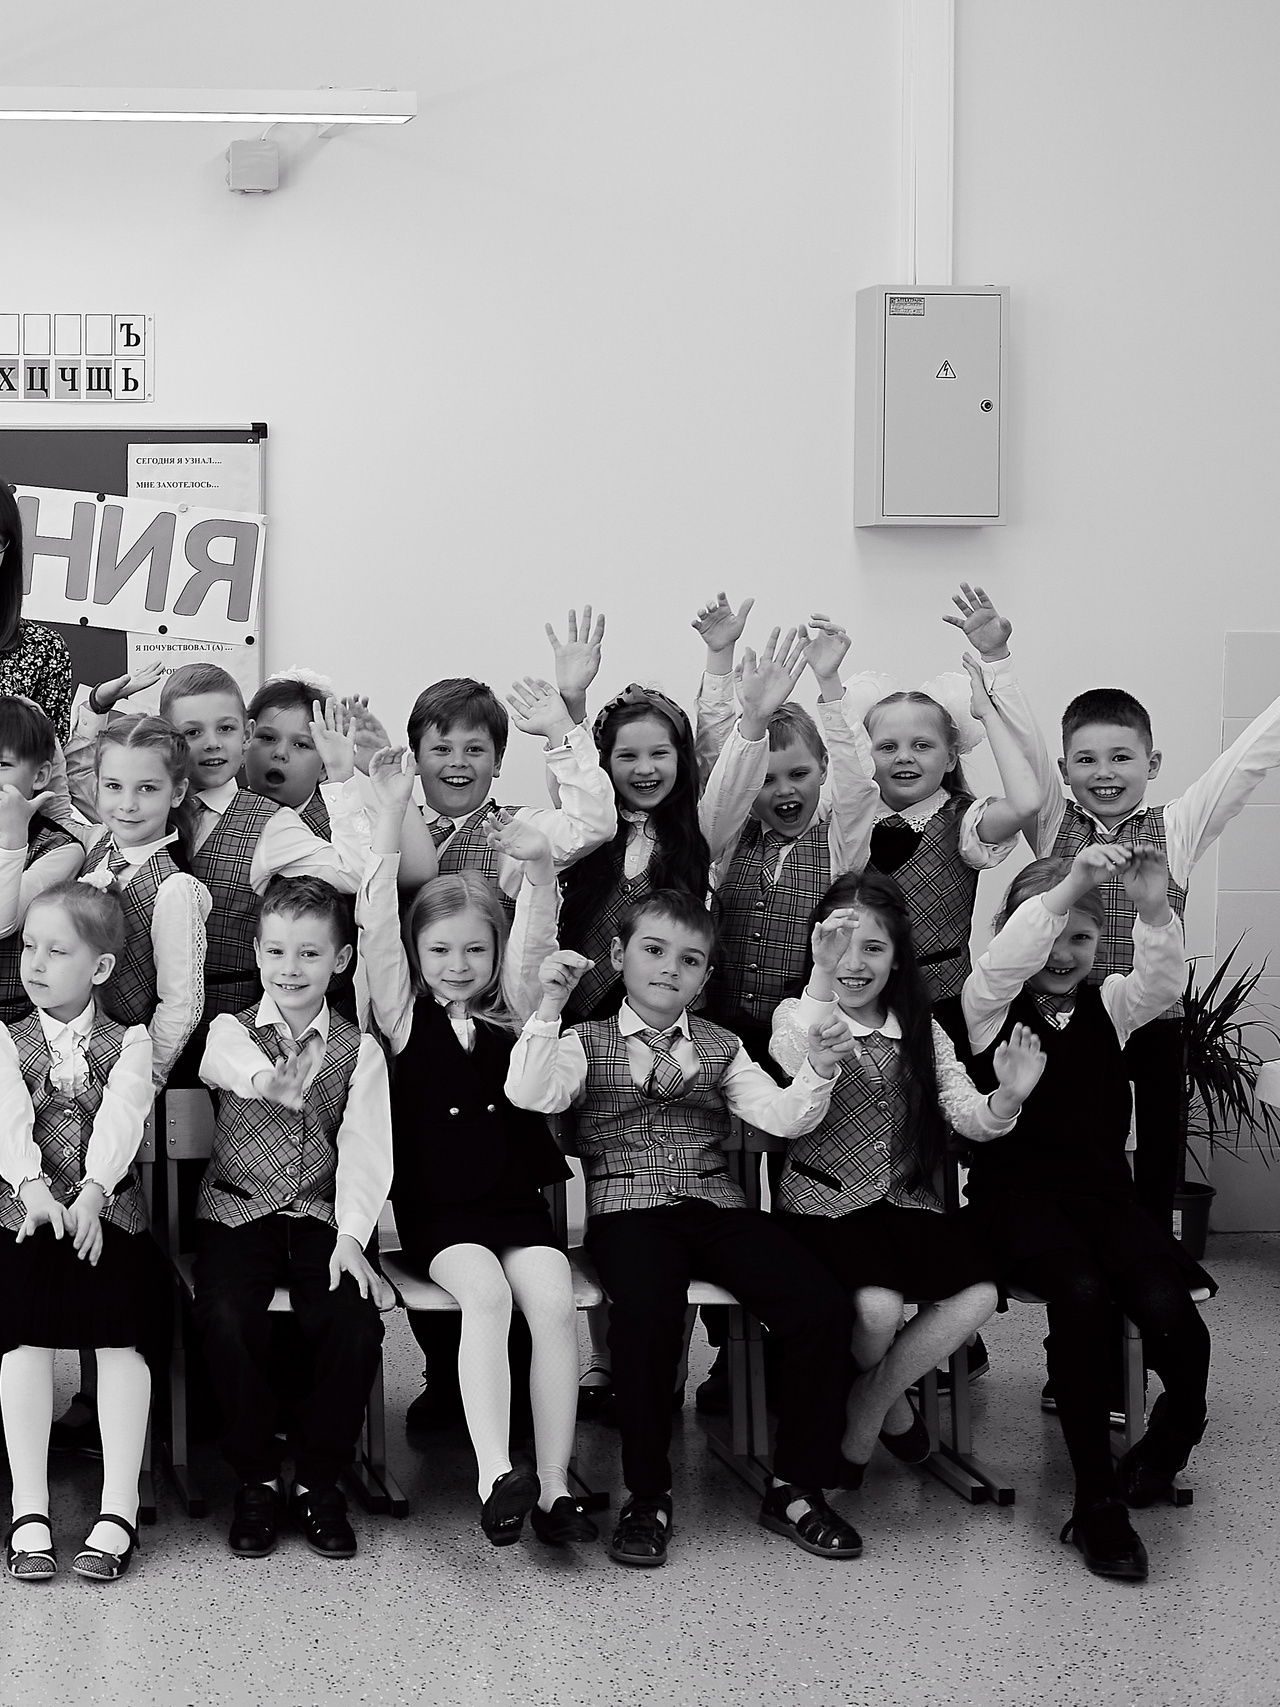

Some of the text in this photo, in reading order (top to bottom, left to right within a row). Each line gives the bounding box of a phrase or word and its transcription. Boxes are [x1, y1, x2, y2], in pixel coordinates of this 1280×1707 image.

[120, 323, 141, 347] Ъ
[26, 367, 48, 397] Ц
[58, 367, 79, 391] Ч
[86, 367, 112, 397] Щ
[121, 368, 139, 392] Ь
[135, 457, 175, 465] СЕГОДНЯ
